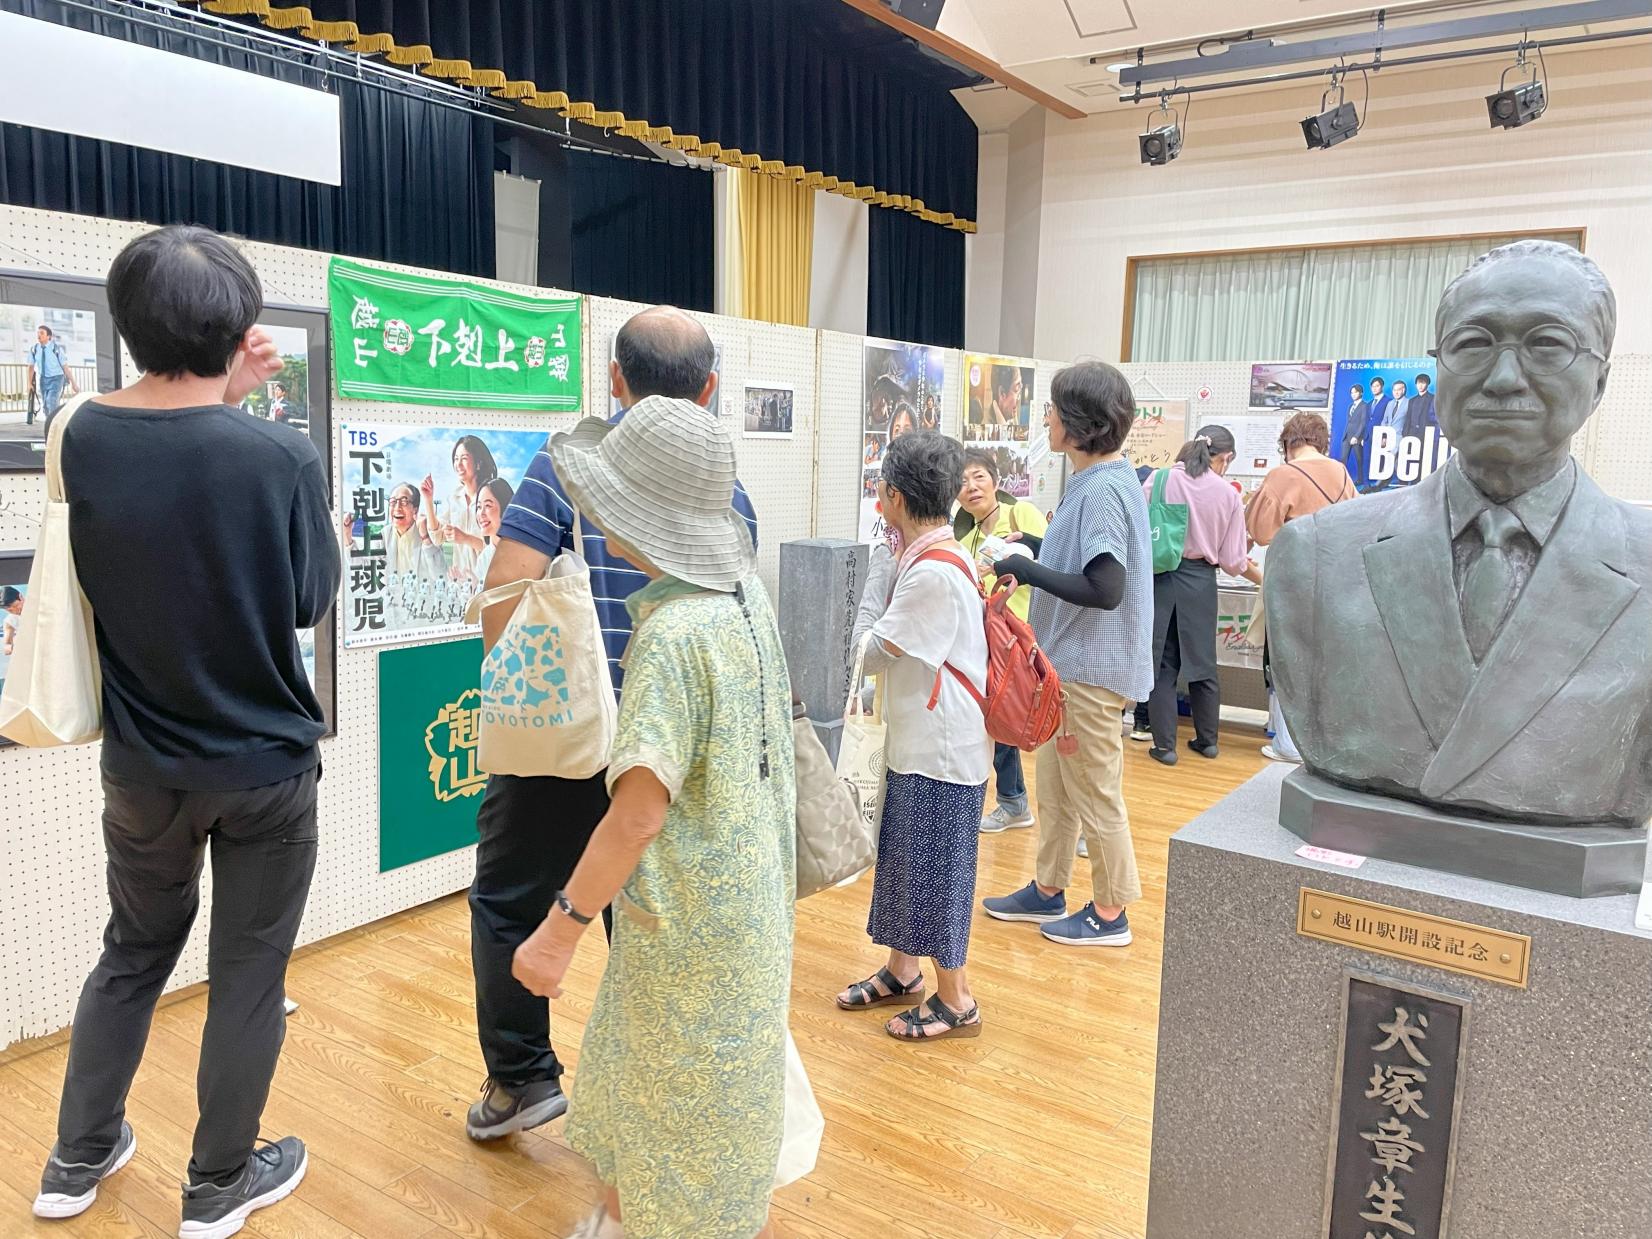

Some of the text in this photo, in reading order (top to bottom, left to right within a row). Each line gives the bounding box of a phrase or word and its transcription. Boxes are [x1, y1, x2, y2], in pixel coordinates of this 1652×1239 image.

[417, 318, 520, 372] 下剋上
[348, 430, 378, 447] TBS
[1369, 425, 1458, 481] Beli
[349, 450, 388, 632] 下剋上球児
[483, 709, 573, 729] OYOTOMI
[1332, 910, 1490, 964] 越山駅開設記念
[1359, 1006, 1432, 1239] 犬塚章生
